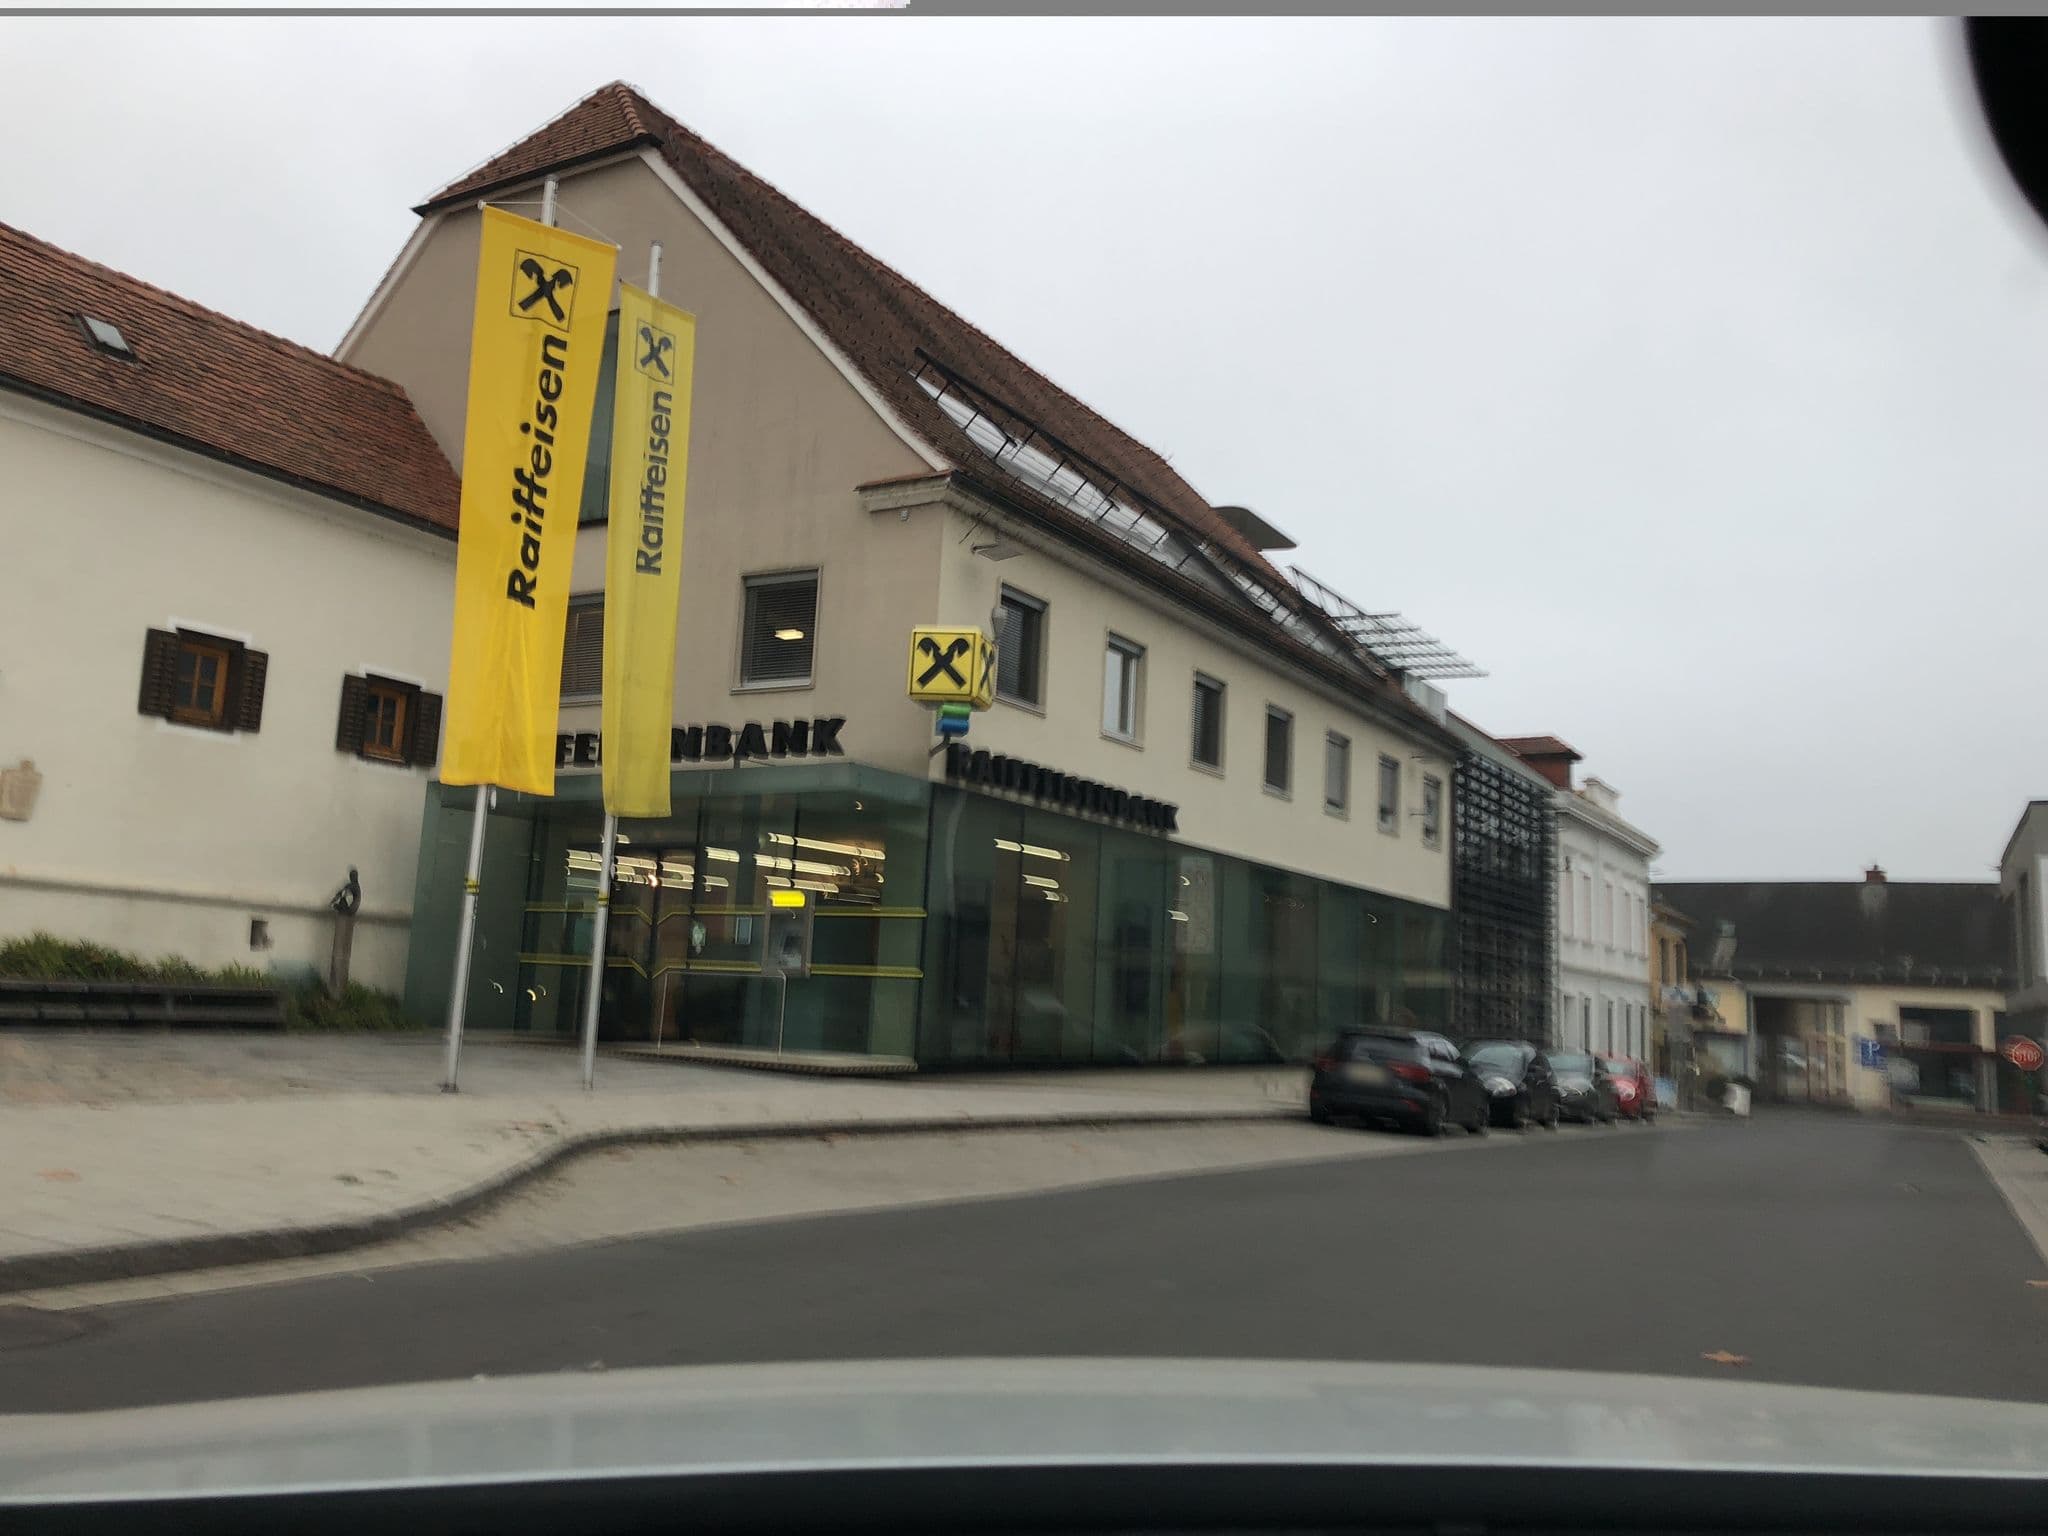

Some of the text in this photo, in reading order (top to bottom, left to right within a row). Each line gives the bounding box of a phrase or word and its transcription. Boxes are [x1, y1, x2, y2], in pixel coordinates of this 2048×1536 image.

[506, 334, 568, 610] Raiffeisen
[635, 390, 673, 577] Raiffeisen
[2016, 1049, 2041, 1063] STOP
